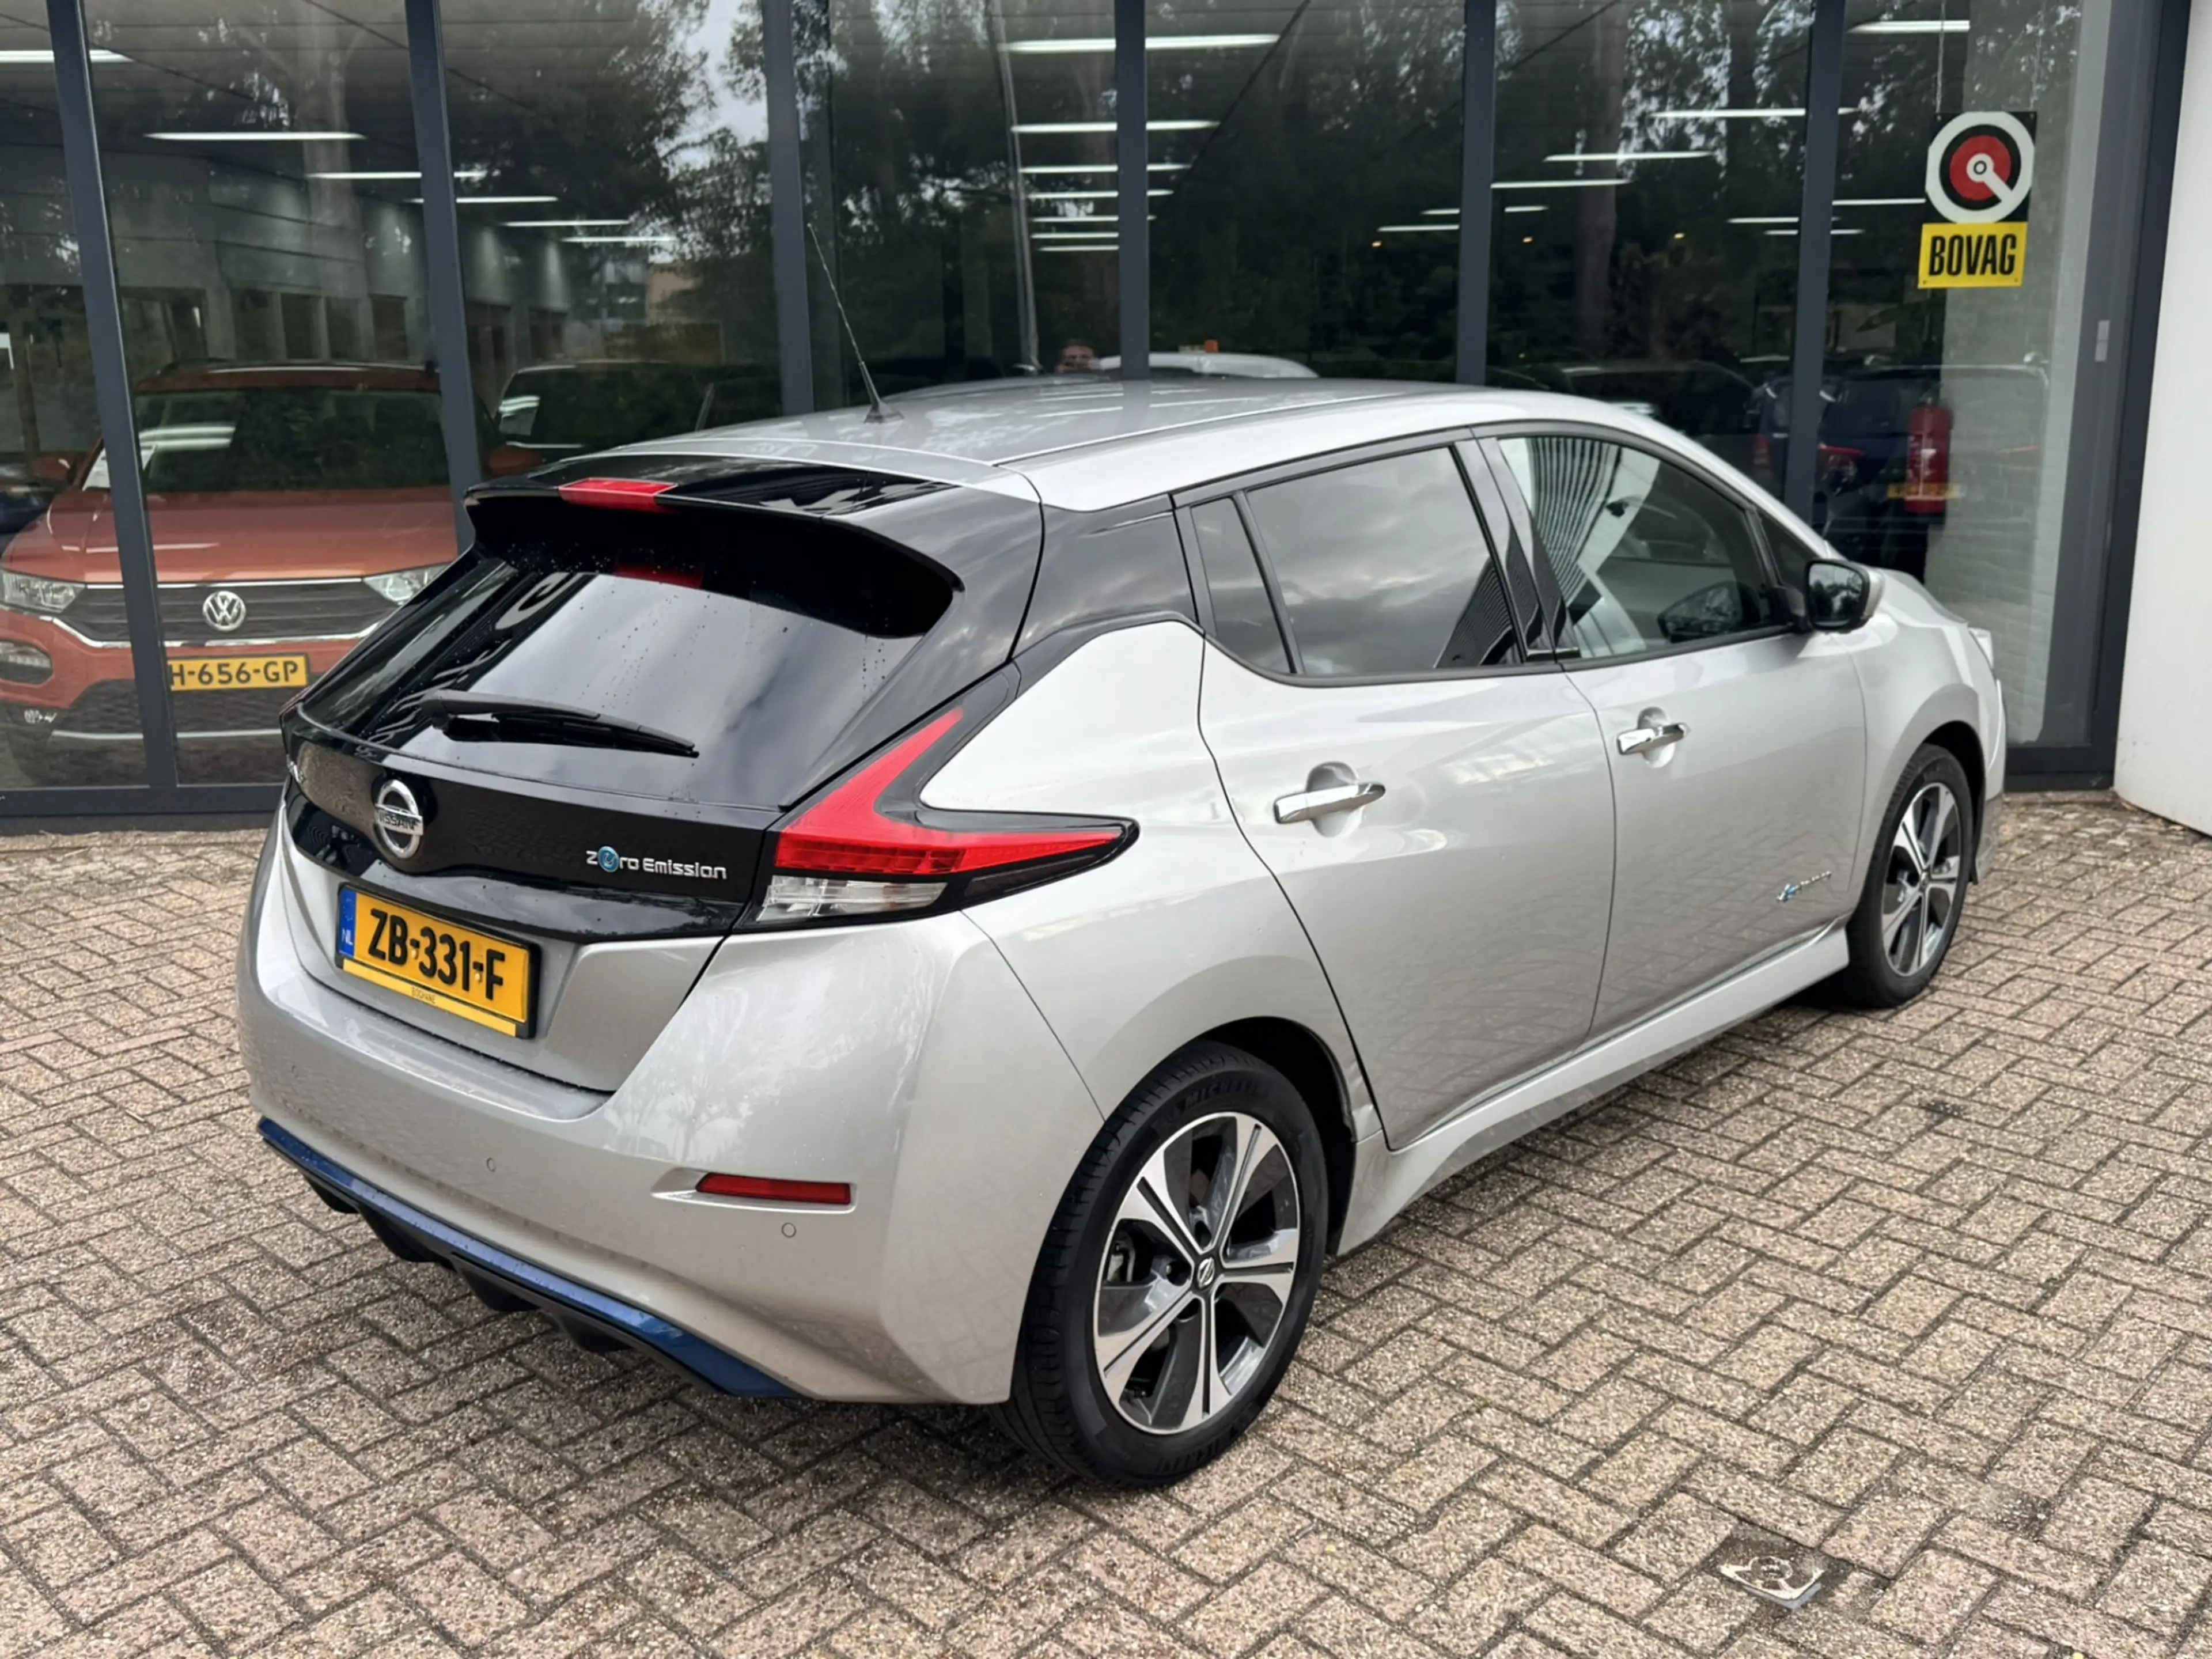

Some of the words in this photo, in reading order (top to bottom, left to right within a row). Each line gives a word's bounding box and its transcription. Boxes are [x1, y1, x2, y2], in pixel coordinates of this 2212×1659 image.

[1928, 233, 2017, 276] BOVAG
[643, 858, 727, 879] Emission
[341, 928, 353, 946] NL
[368, 907, 506, 1000] ZB-331-F
